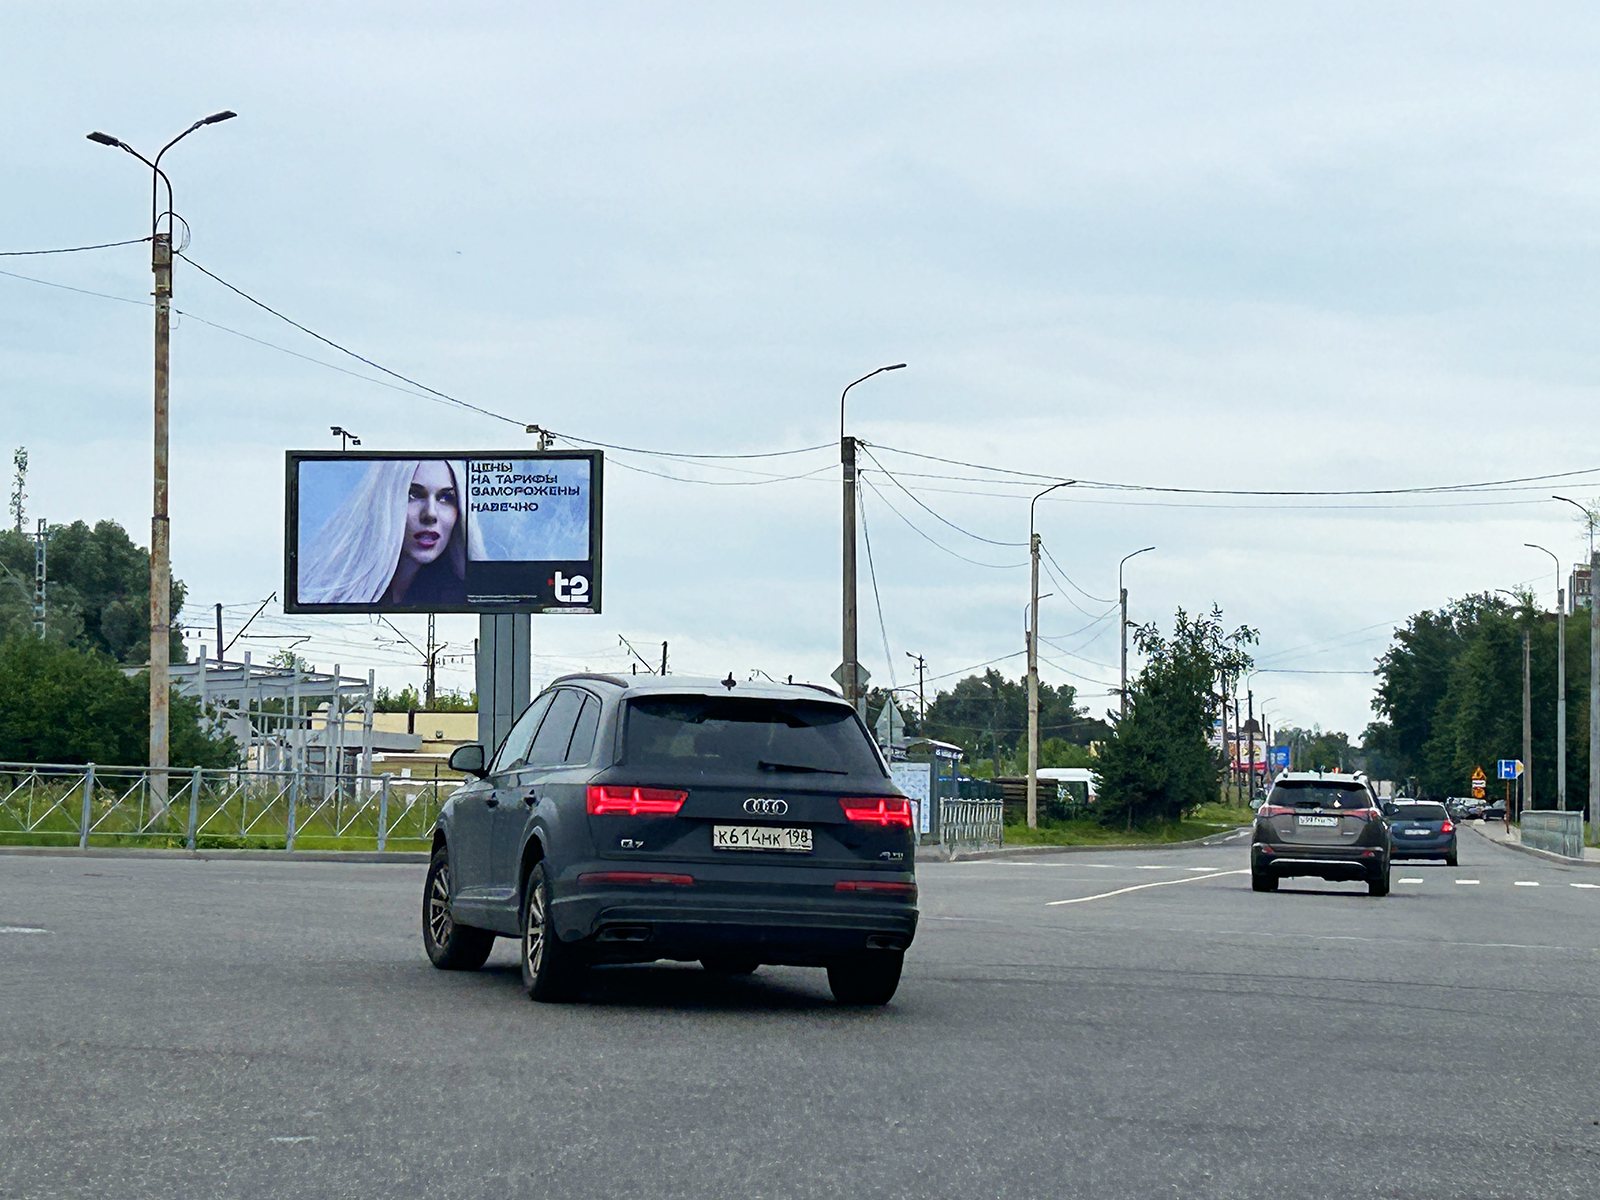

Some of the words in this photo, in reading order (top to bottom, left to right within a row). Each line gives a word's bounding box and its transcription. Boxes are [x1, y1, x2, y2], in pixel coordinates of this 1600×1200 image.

[471, 462, 512, 472] ЦЕНЫ
[471, 474, 490, 484] НА
[495, 474, 557, 484] ТАРИФЫ
[471, 486, 580, 496] ЗАМОРОЖЕНЫ
[471, 502, 539, 512] НАВЕЧНО
[554, 571, 589, 602] t2
